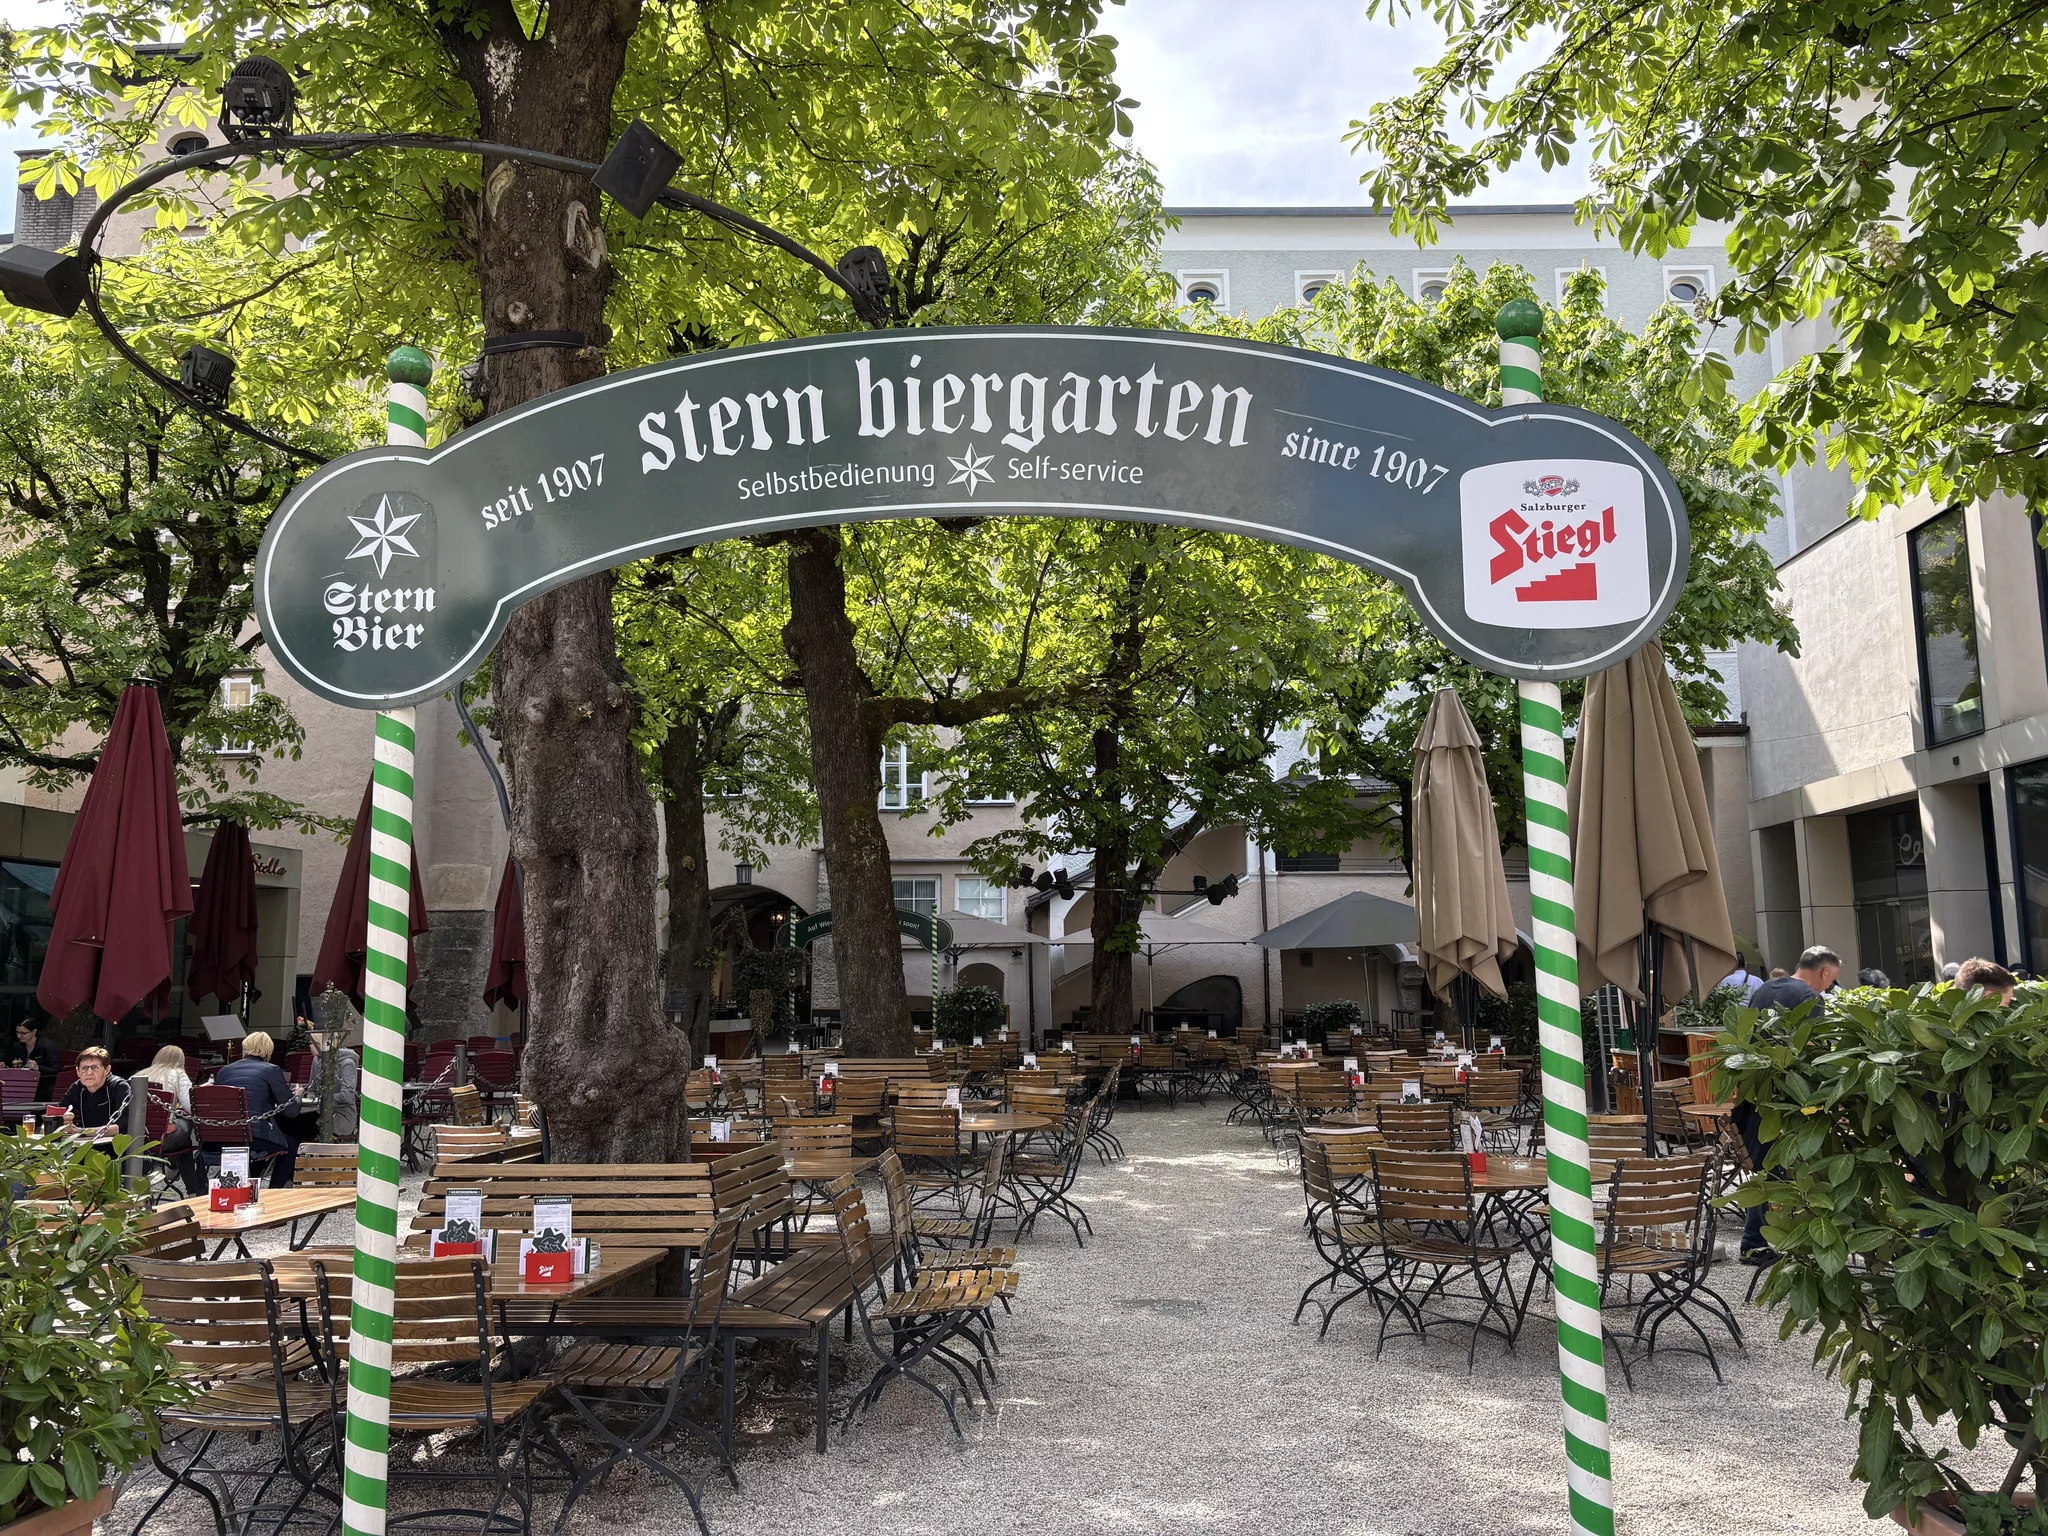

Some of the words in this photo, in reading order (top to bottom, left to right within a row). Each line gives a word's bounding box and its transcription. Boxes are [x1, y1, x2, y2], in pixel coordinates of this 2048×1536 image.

[638, 384, 831, 475] stern
[855, 354, 1254, 454] biergarten
[737, 462, 936, 500] Selbstbedienung
[1007, 455, 1144, 485] Self-service
[1280, 427, 1361, 472] since
[1369, 445, 1450, 496] 1907
[481, 485, 534, 531] seit
[537, 453, 605, 503] 1907
[1520, 502, 1587, 514] Salzburger
[1489, 505, 1618, 585] Stiegl
[324, 572, 436, 615] Stern
[332, 616, 424, 652] Bier
